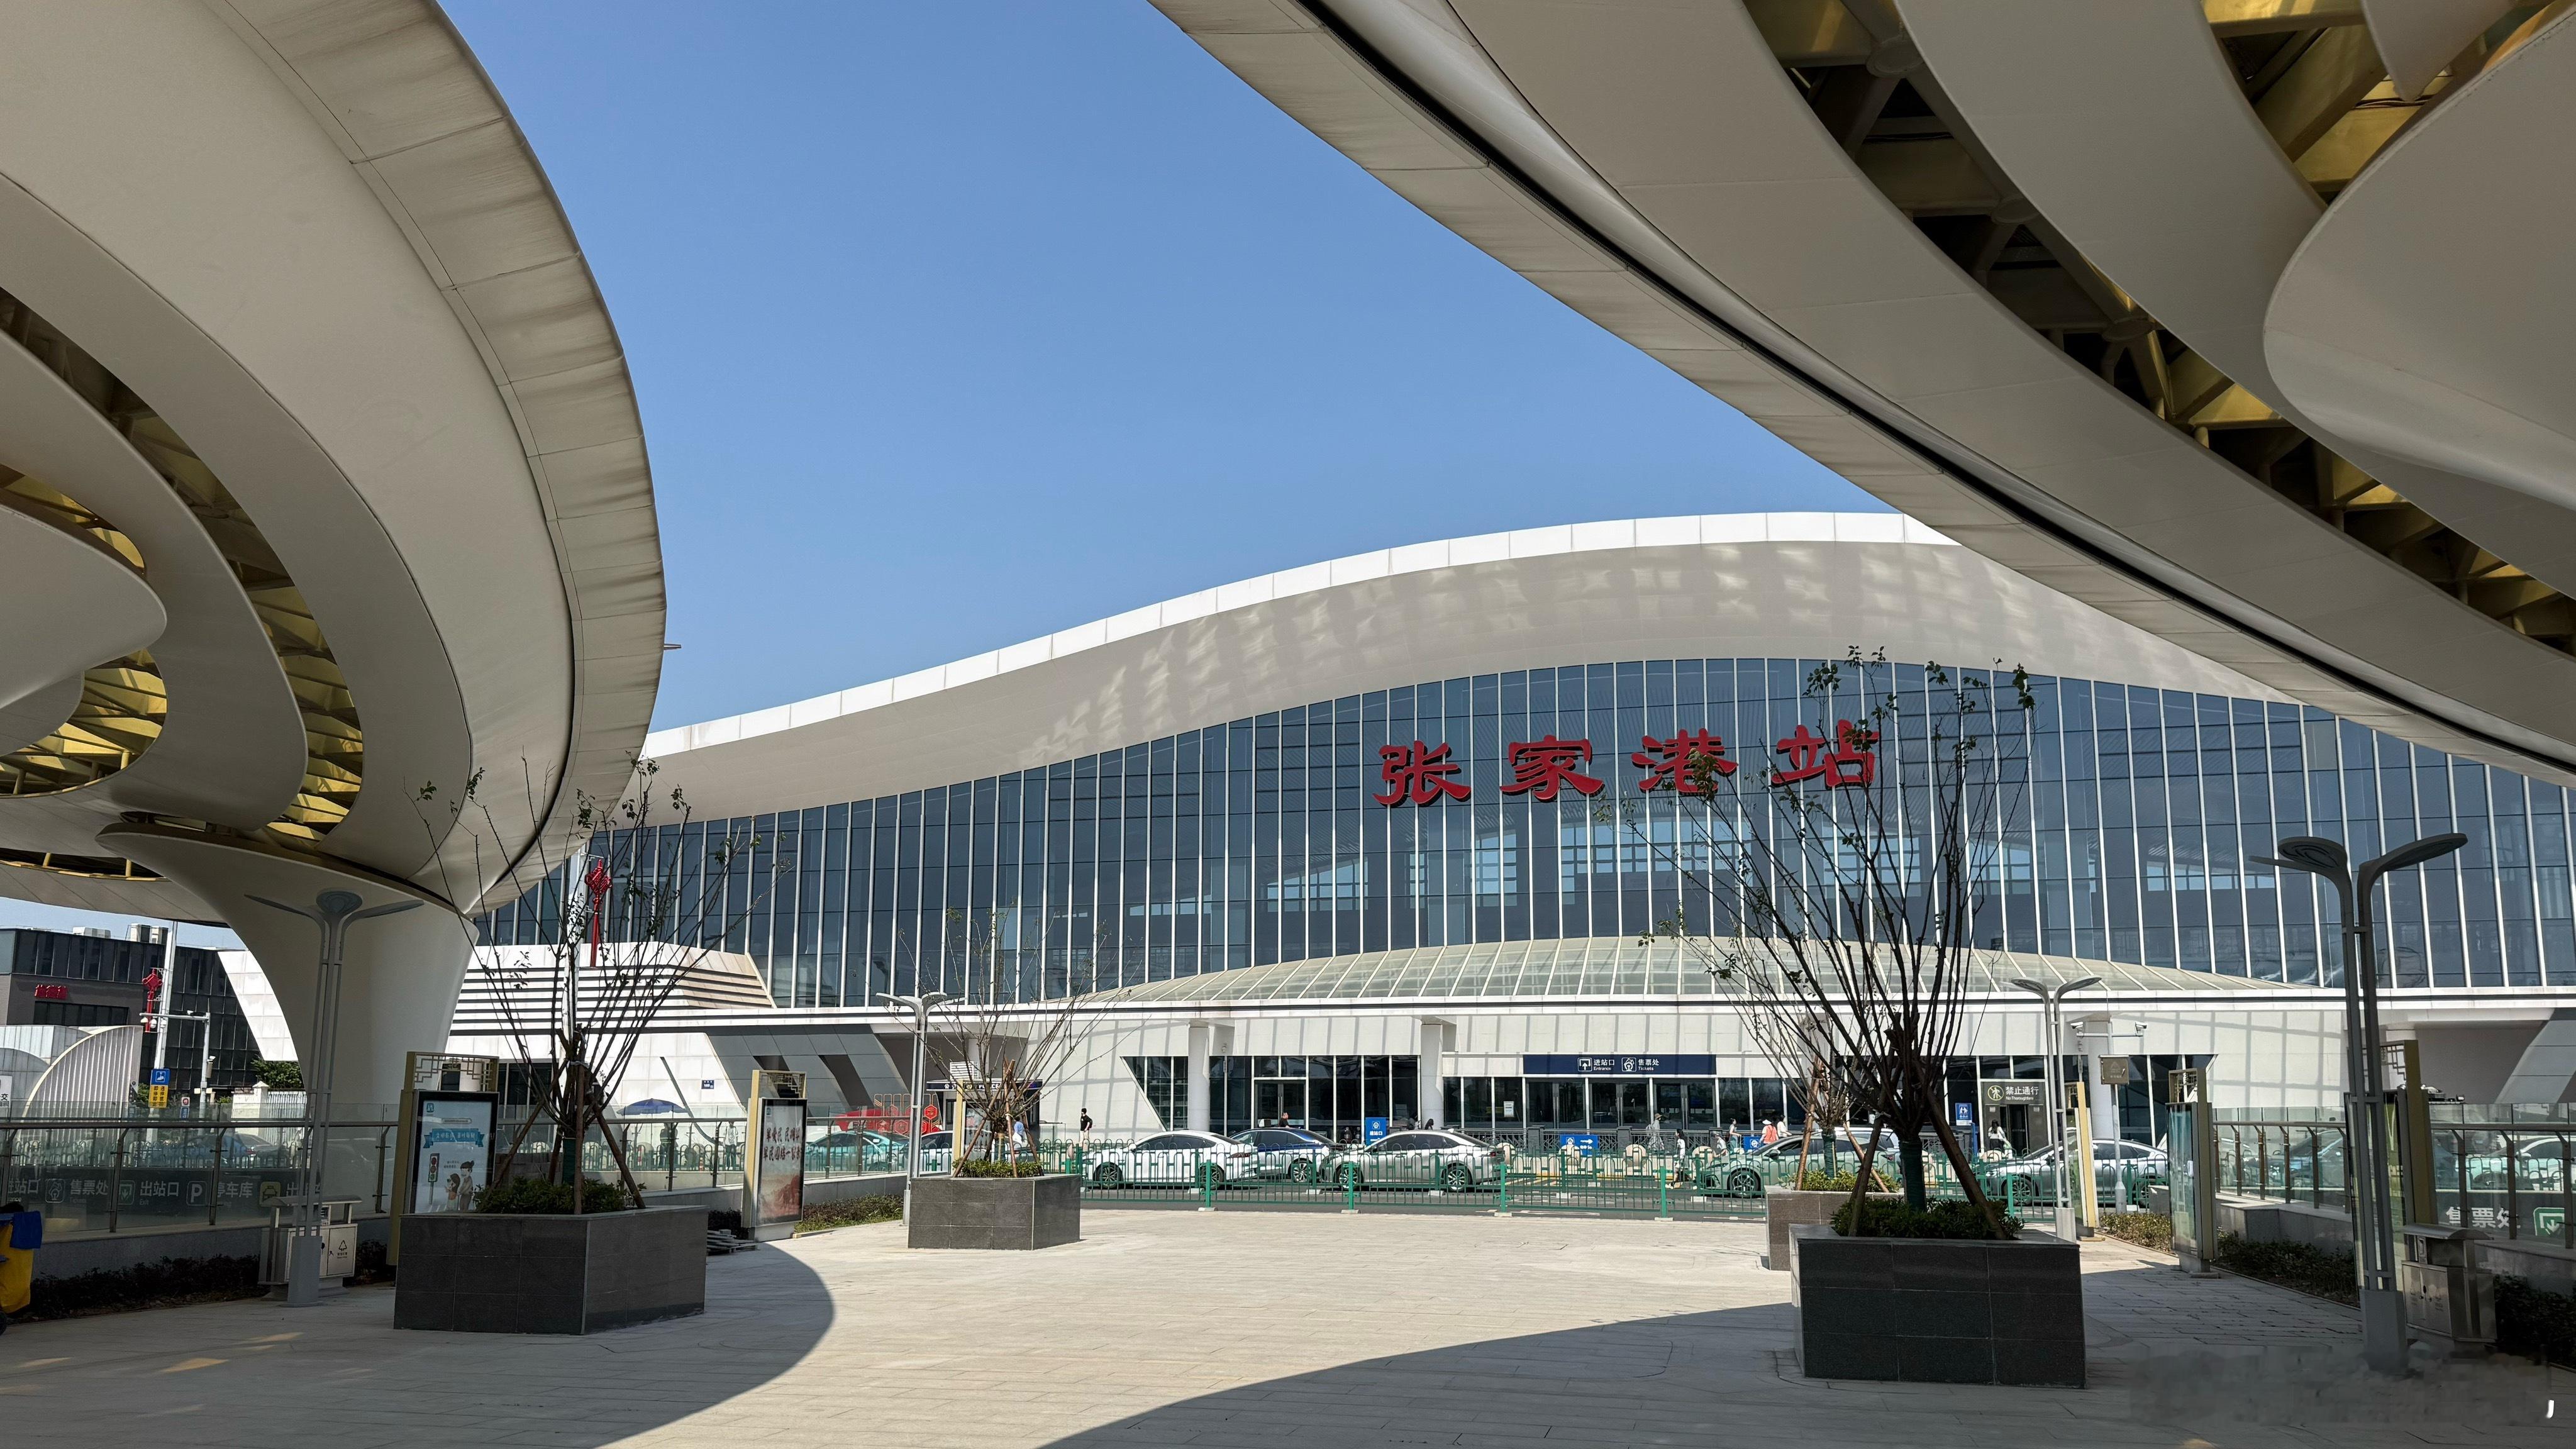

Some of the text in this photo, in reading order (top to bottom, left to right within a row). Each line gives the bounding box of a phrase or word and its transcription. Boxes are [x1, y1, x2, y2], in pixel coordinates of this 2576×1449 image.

[1372, 719, 1880, 806] 张家港站
[2006, 1086, 2039, 1095] 禁止通行
[70, 1179, 108, 1195] 售票处
[140, 1180, 179, 1197] 出站口
